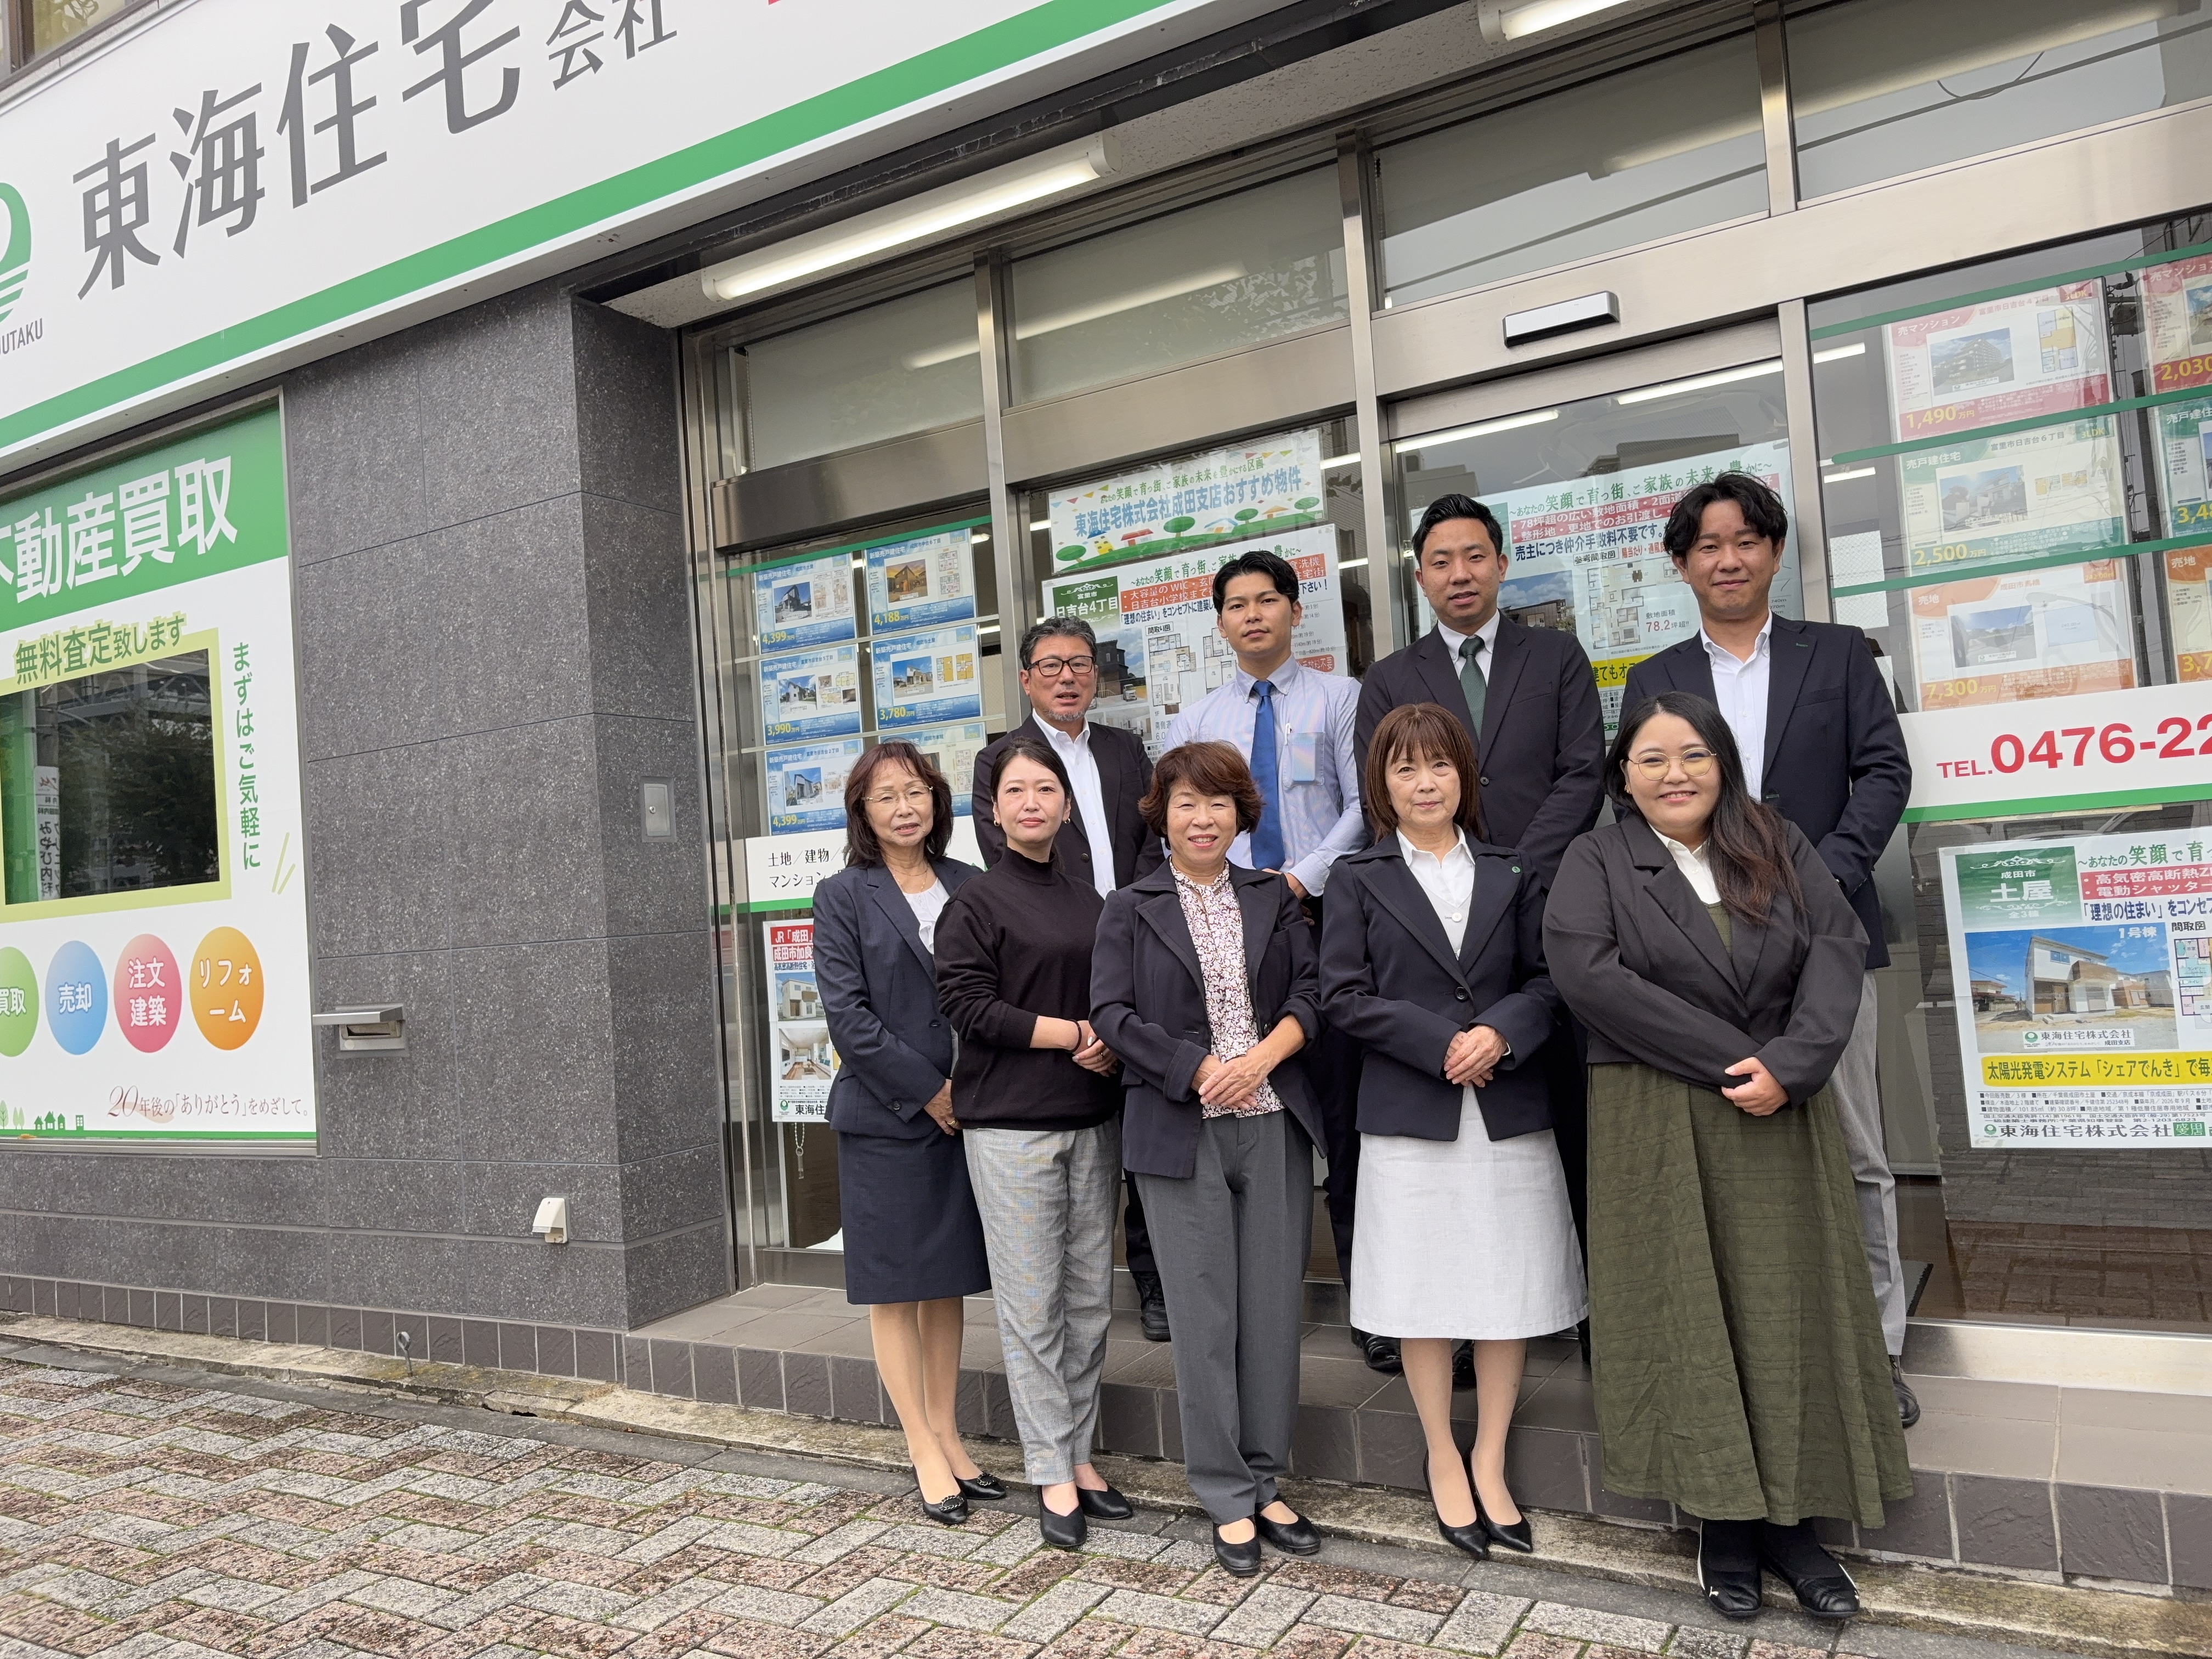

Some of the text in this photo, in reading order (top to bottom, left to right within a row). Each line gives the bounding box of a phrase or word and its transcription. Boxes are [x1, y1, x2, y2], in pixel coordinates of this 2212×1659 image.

[2150, 263, 2212, 283] 売マンショ
[1897, 315, 1960, 337] 売マンション
[1979, 294, 2049, 315] 富里市日吉台4丁目
[0, 318, 43, 354] UTAKU
[1906, 405, 1975, 429] 1,490万円
[1906, 452, 1961, 470] 売戸建住宅
[1990, 431, 2064, 452] 富里市日吉台6丁目
[1075, 465, 1302, 538] 東海住宅株式会社成田支店おすすめ物件
[1513, 490, 1686, 529] ・78坪超の広い敷地面積・2面道
[1515, 522, 1668, 562] 売主につき仲介手数料不要です。
[1574, 550, 1616, 565] 参考間取図
[1915, 544, 1987, 567] 2,500万円
[2171, 556, 2196, 568] 売地
[1056, 596, 1118, 618] 日吉台4丁目
[1077, 591, 1097, 600] 富里市
[1918, 594, 1939, 606] 売地
[1646, 609, 1676, 619] 敷地面積
[16, 615, 185, 685] 無料査定致します
[1926, 680, 1996, 700] 7,300万円
[233, 642, 261, 870] まずはご気軽に
[2001, 870, 2036, 879] 成田市
[2084, 867, 2212, 885] ・高気密高断熱Z
[1990, 880, 2053, 902] 土屋
[2008, 910, 2039, 919] 全3棟
[2118, 927, 2157, 939] 1号棟
[2171, 921, 2206, 932] 間取図
[774, 945, 814, 961] 成田市加良
[128, 957, 164, 989] 注文
[199, 958, 252, 988] リフォ
[0, 988, 26, 1015] 買取
[58, 983, 92, 1014] 売却
[130, 996, 166, 1027] 建築
[210, 1000, 246, 1023] ーム
[2040, 1029, 2132, 1041] 東海住宅株式会社
[1988, 1057, 2212, 1080] 太陽光発電システム「シェアでんき」で毎
[107, 1085, 308, 1117] 20年後の「ありがとう」をめざして。
[1999, 1124, 2172, 1138] 東海住宅株式会社
